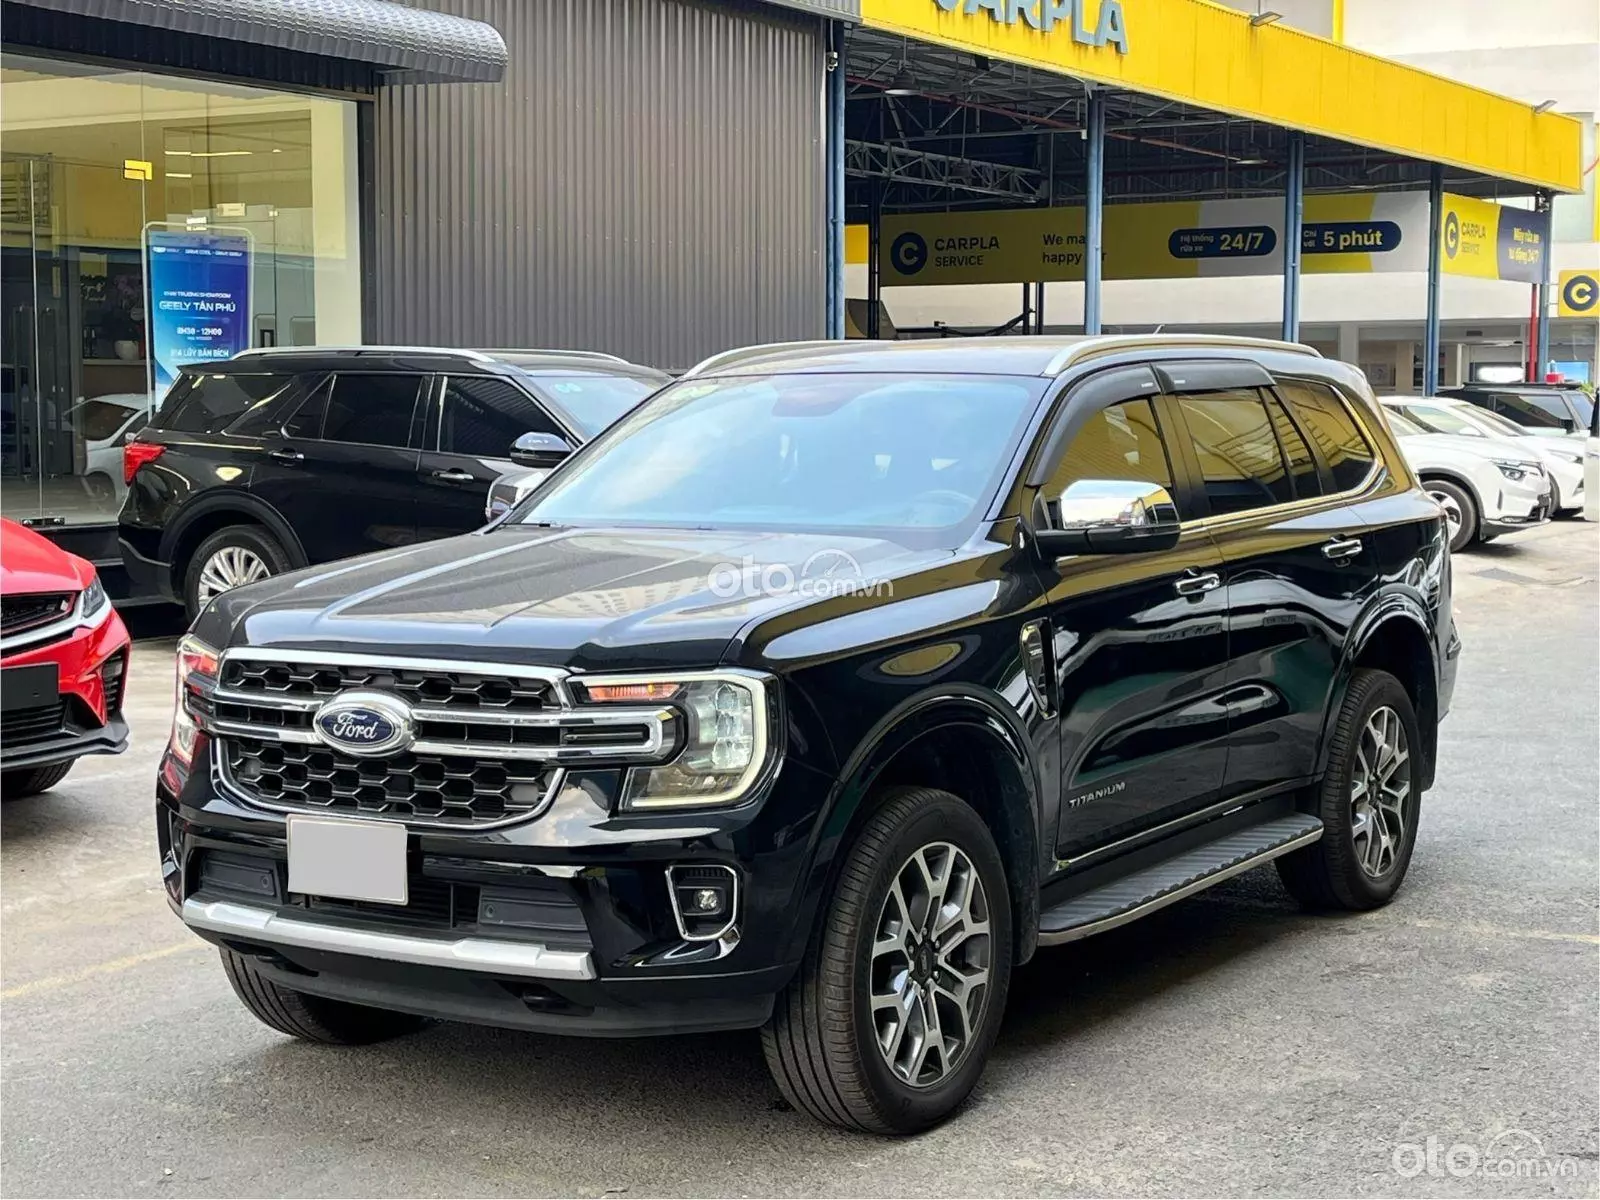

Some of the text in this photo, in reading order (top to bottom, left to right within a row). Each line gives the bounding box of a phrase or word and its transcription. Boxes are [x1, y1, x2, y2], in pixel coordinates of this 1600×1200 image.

[1461, 221, 1487, 239] CARPLA
[934, 236, 1000, 251] CARPLA
[1042, 233, 1087, 245] We ma
[1220, 233, 1264, 252] 24/7
[1323, 229, 1383, 250] 5 phút
[934, 255, 984, 267] SERVICE
[1042, 252, 1082, 265] happy
[159, 300, 236, 313] GEELY TÂN PHÚ
[332, 712, 379, 739] Ford
[1069, 781, 1126, 808] TITANIUM
